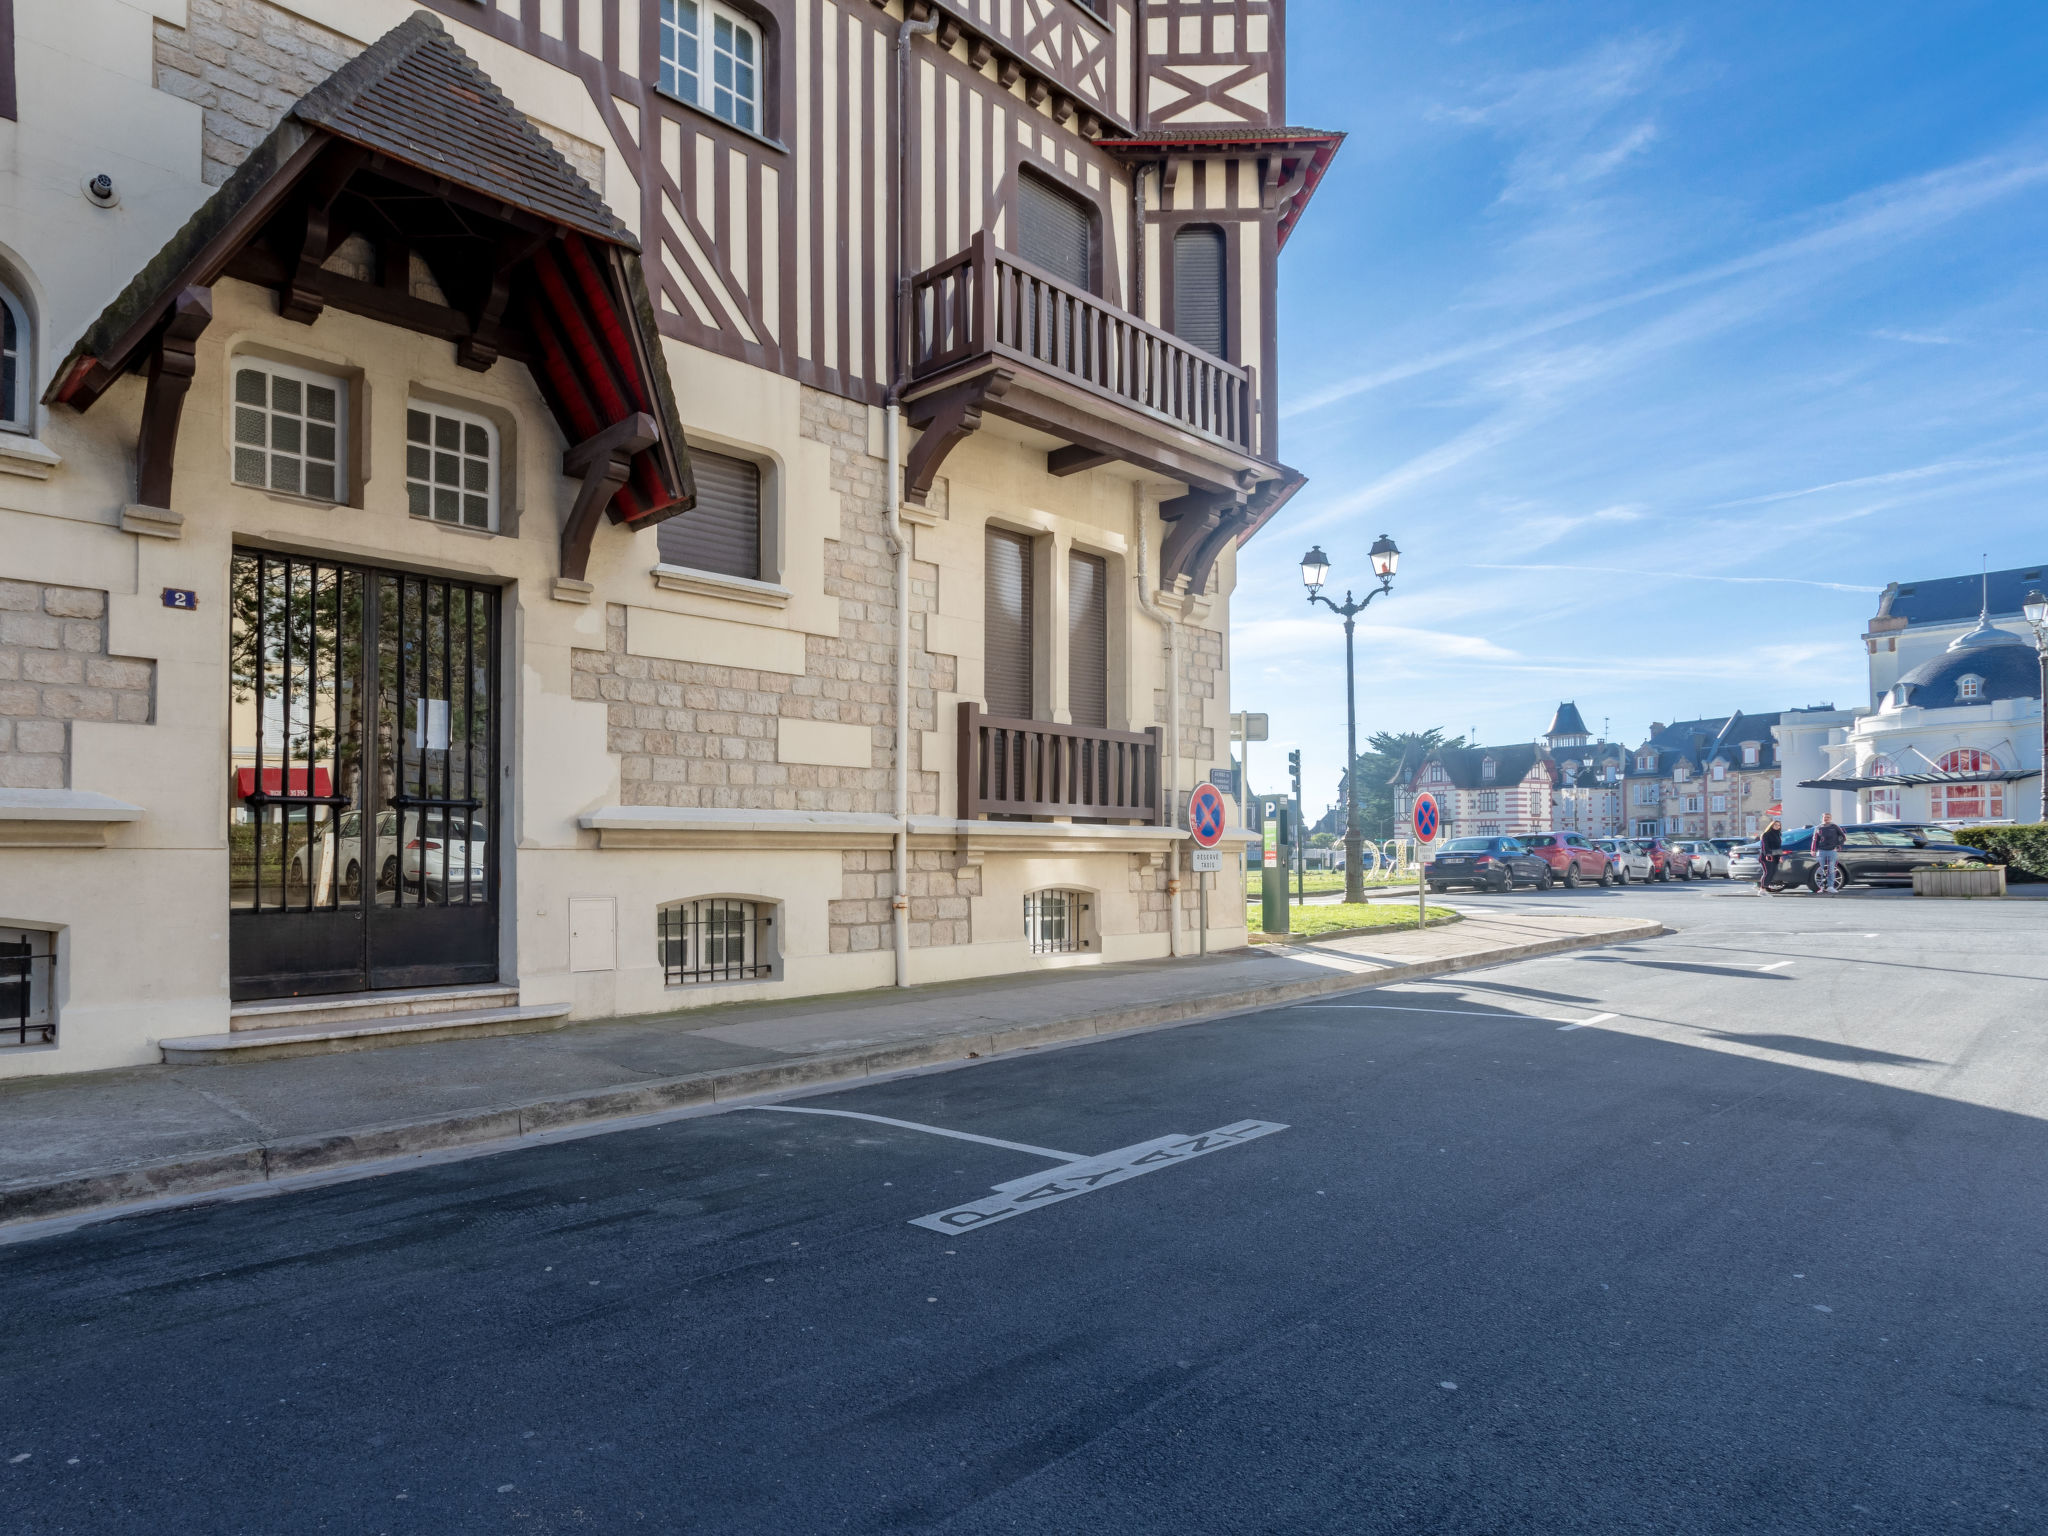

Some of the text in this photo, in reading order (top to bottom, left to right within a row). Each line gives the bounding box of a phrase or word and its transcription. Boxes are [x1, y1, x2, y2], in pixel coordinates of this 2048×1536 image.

[174, 592, 186, 606] 2
[1265, 801, 1276, 817] P
[938, 1123, 1264, 1228] PAYANT
